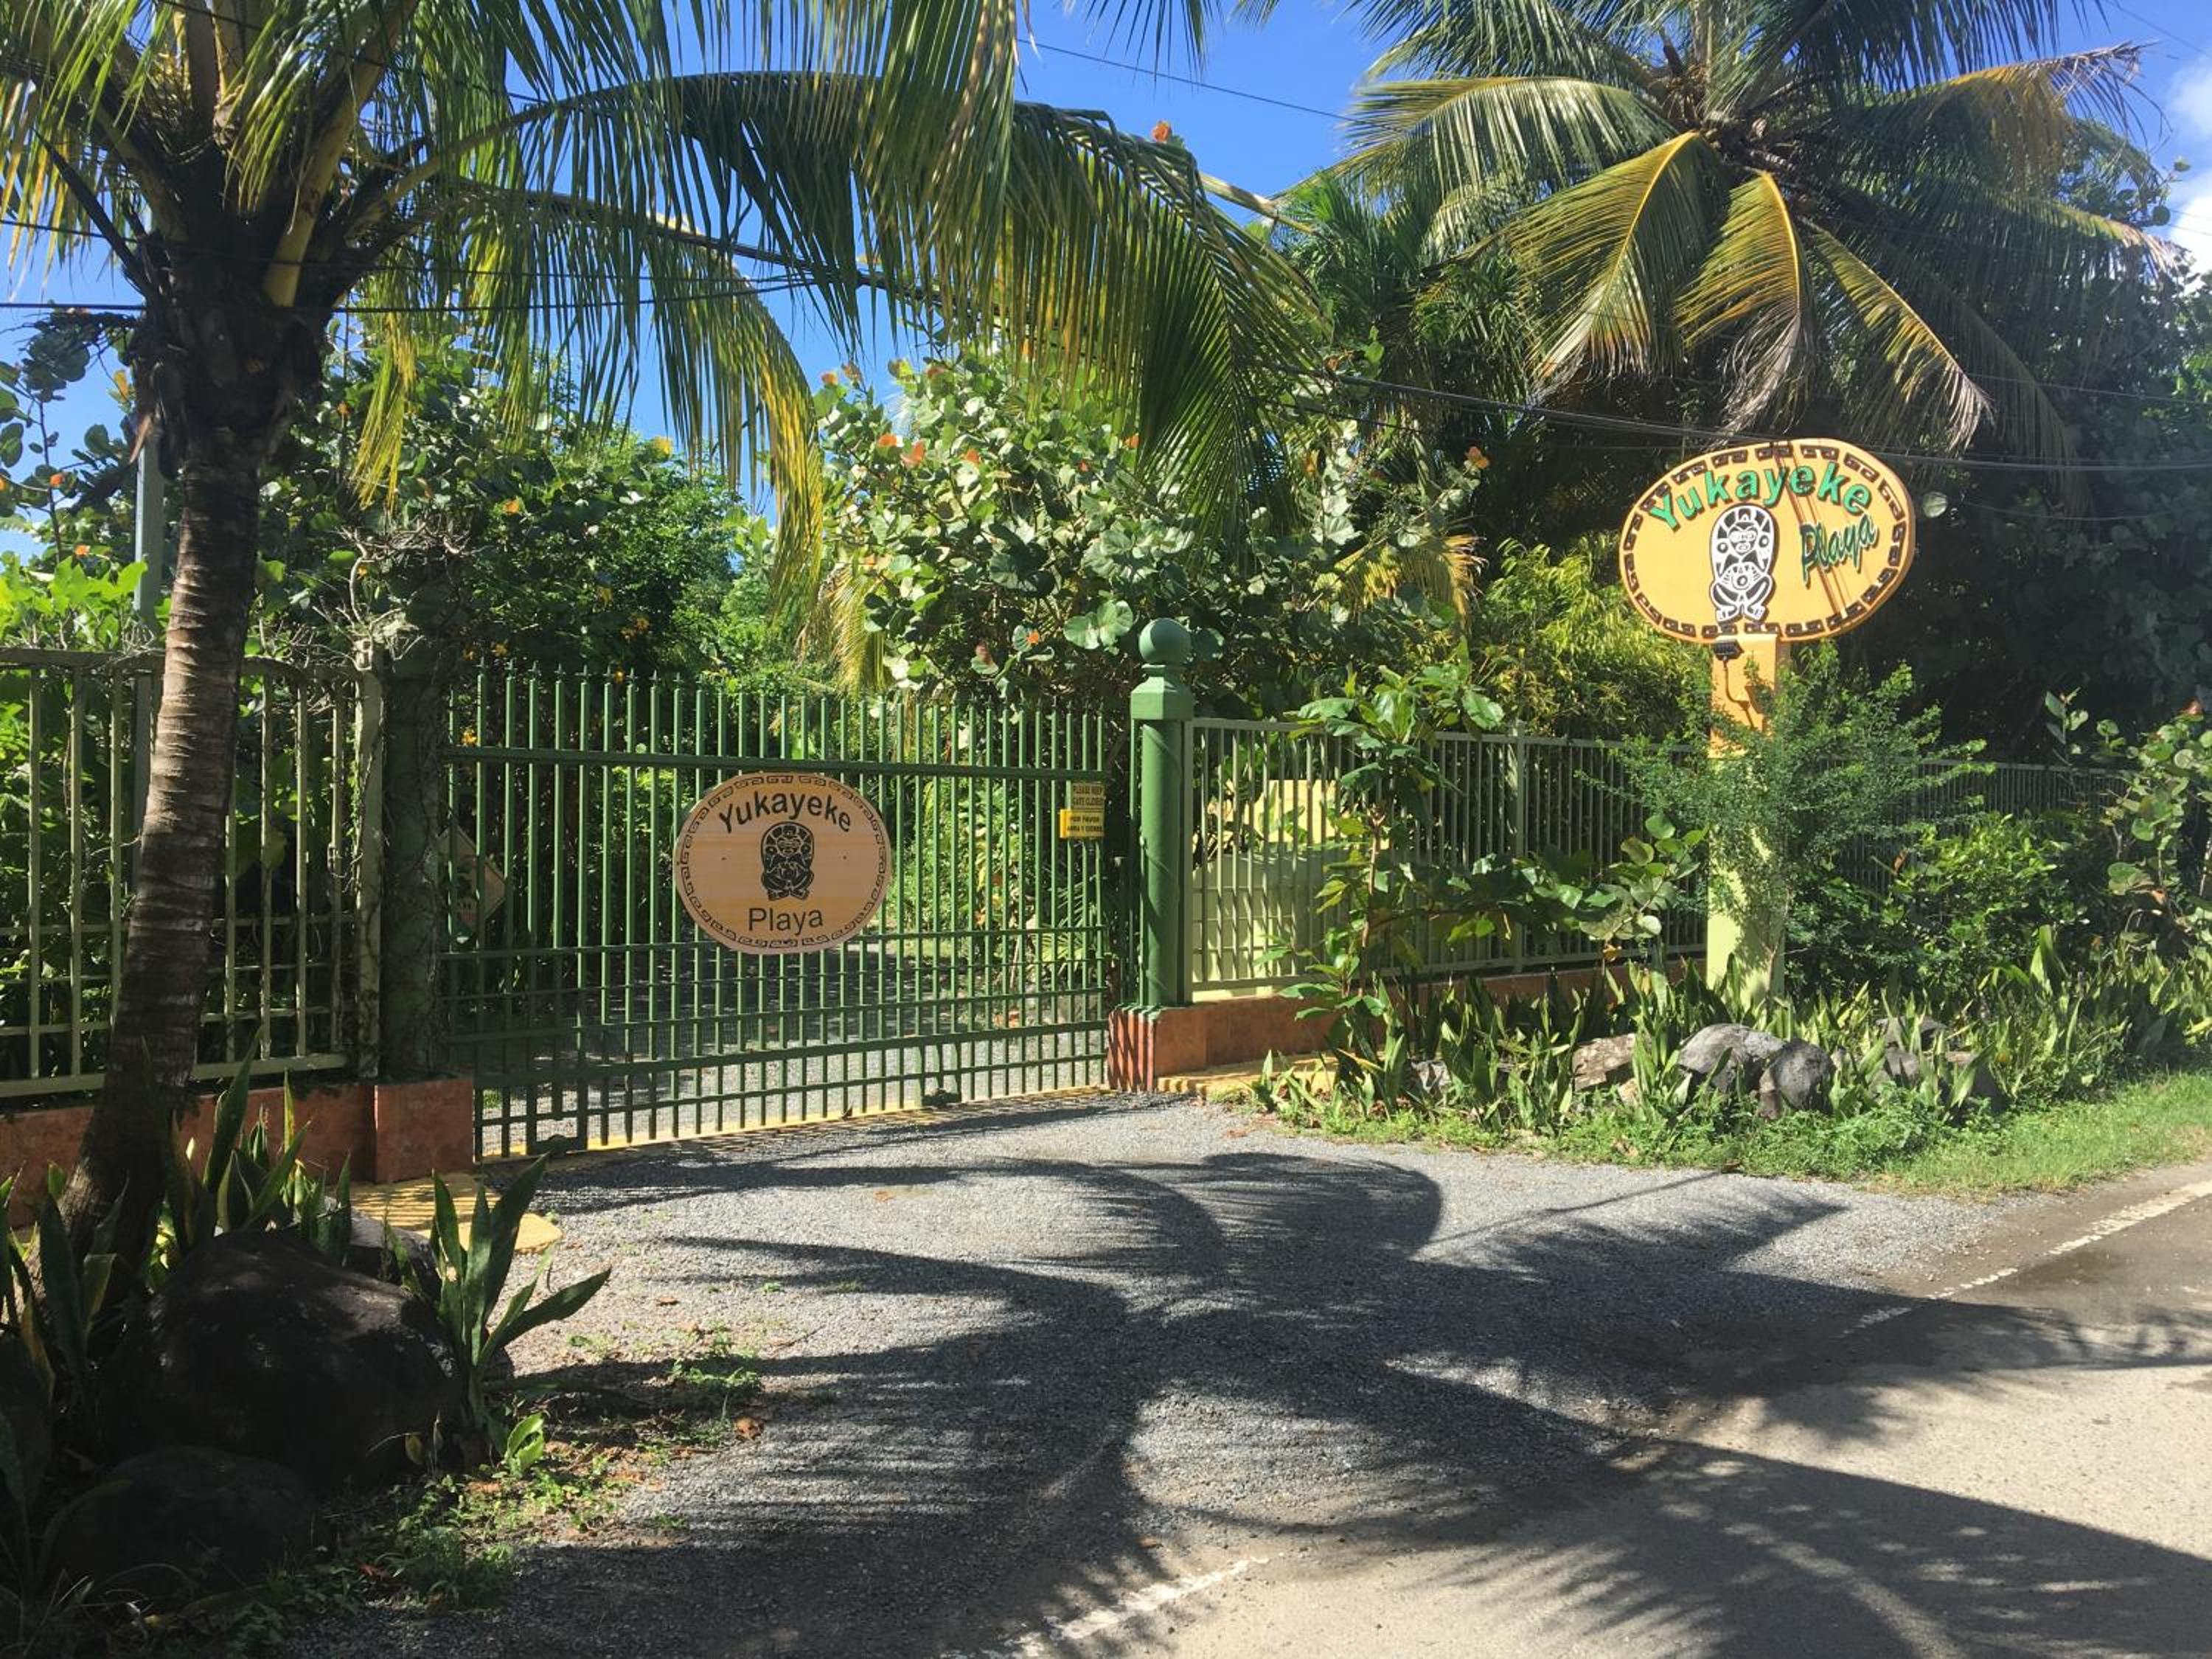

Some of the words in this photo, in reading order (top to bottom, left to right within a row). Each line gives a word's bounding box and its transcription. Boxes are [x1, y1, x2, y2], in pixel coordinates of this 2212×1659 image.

[1649, 461, 1874, 530] Yukayeke
[1799, 513, 1879, 588] Playa
[719, 790, 852, 834] Yukayeke
[748, 908, 824, 936] Playa
